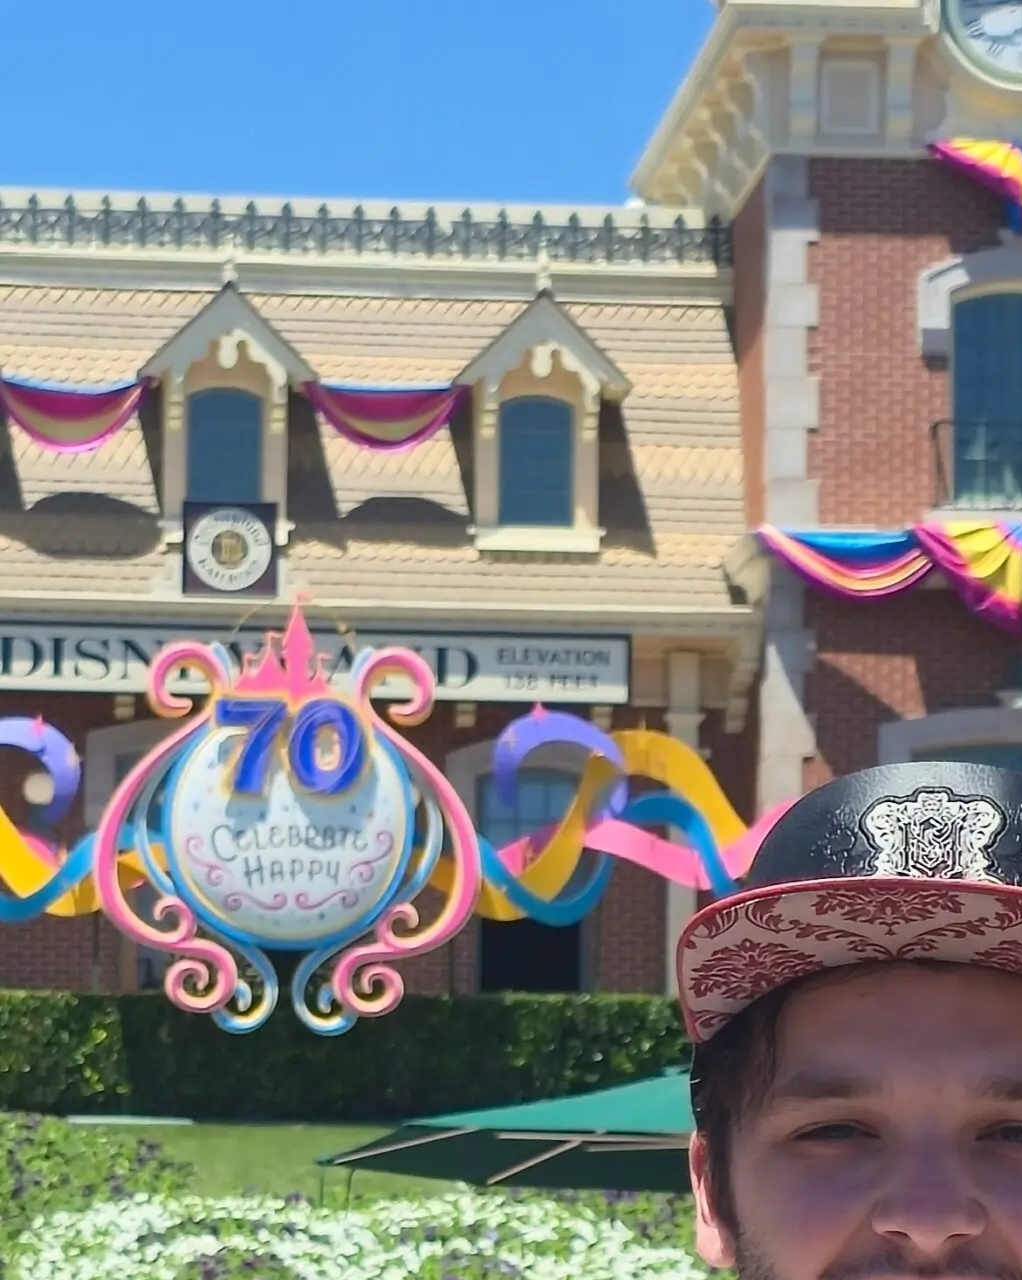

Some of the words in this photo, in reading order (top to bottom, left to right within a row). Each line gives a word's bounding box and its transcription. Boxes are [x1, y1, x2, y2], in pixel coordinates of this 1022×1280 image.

[497, 647, 611, 666] ELEVATION
[214, 699, 365, 795] 70
[211, 824, 368, 862] CELEBRATE
[244, 855, 340, 887] HAPPY
